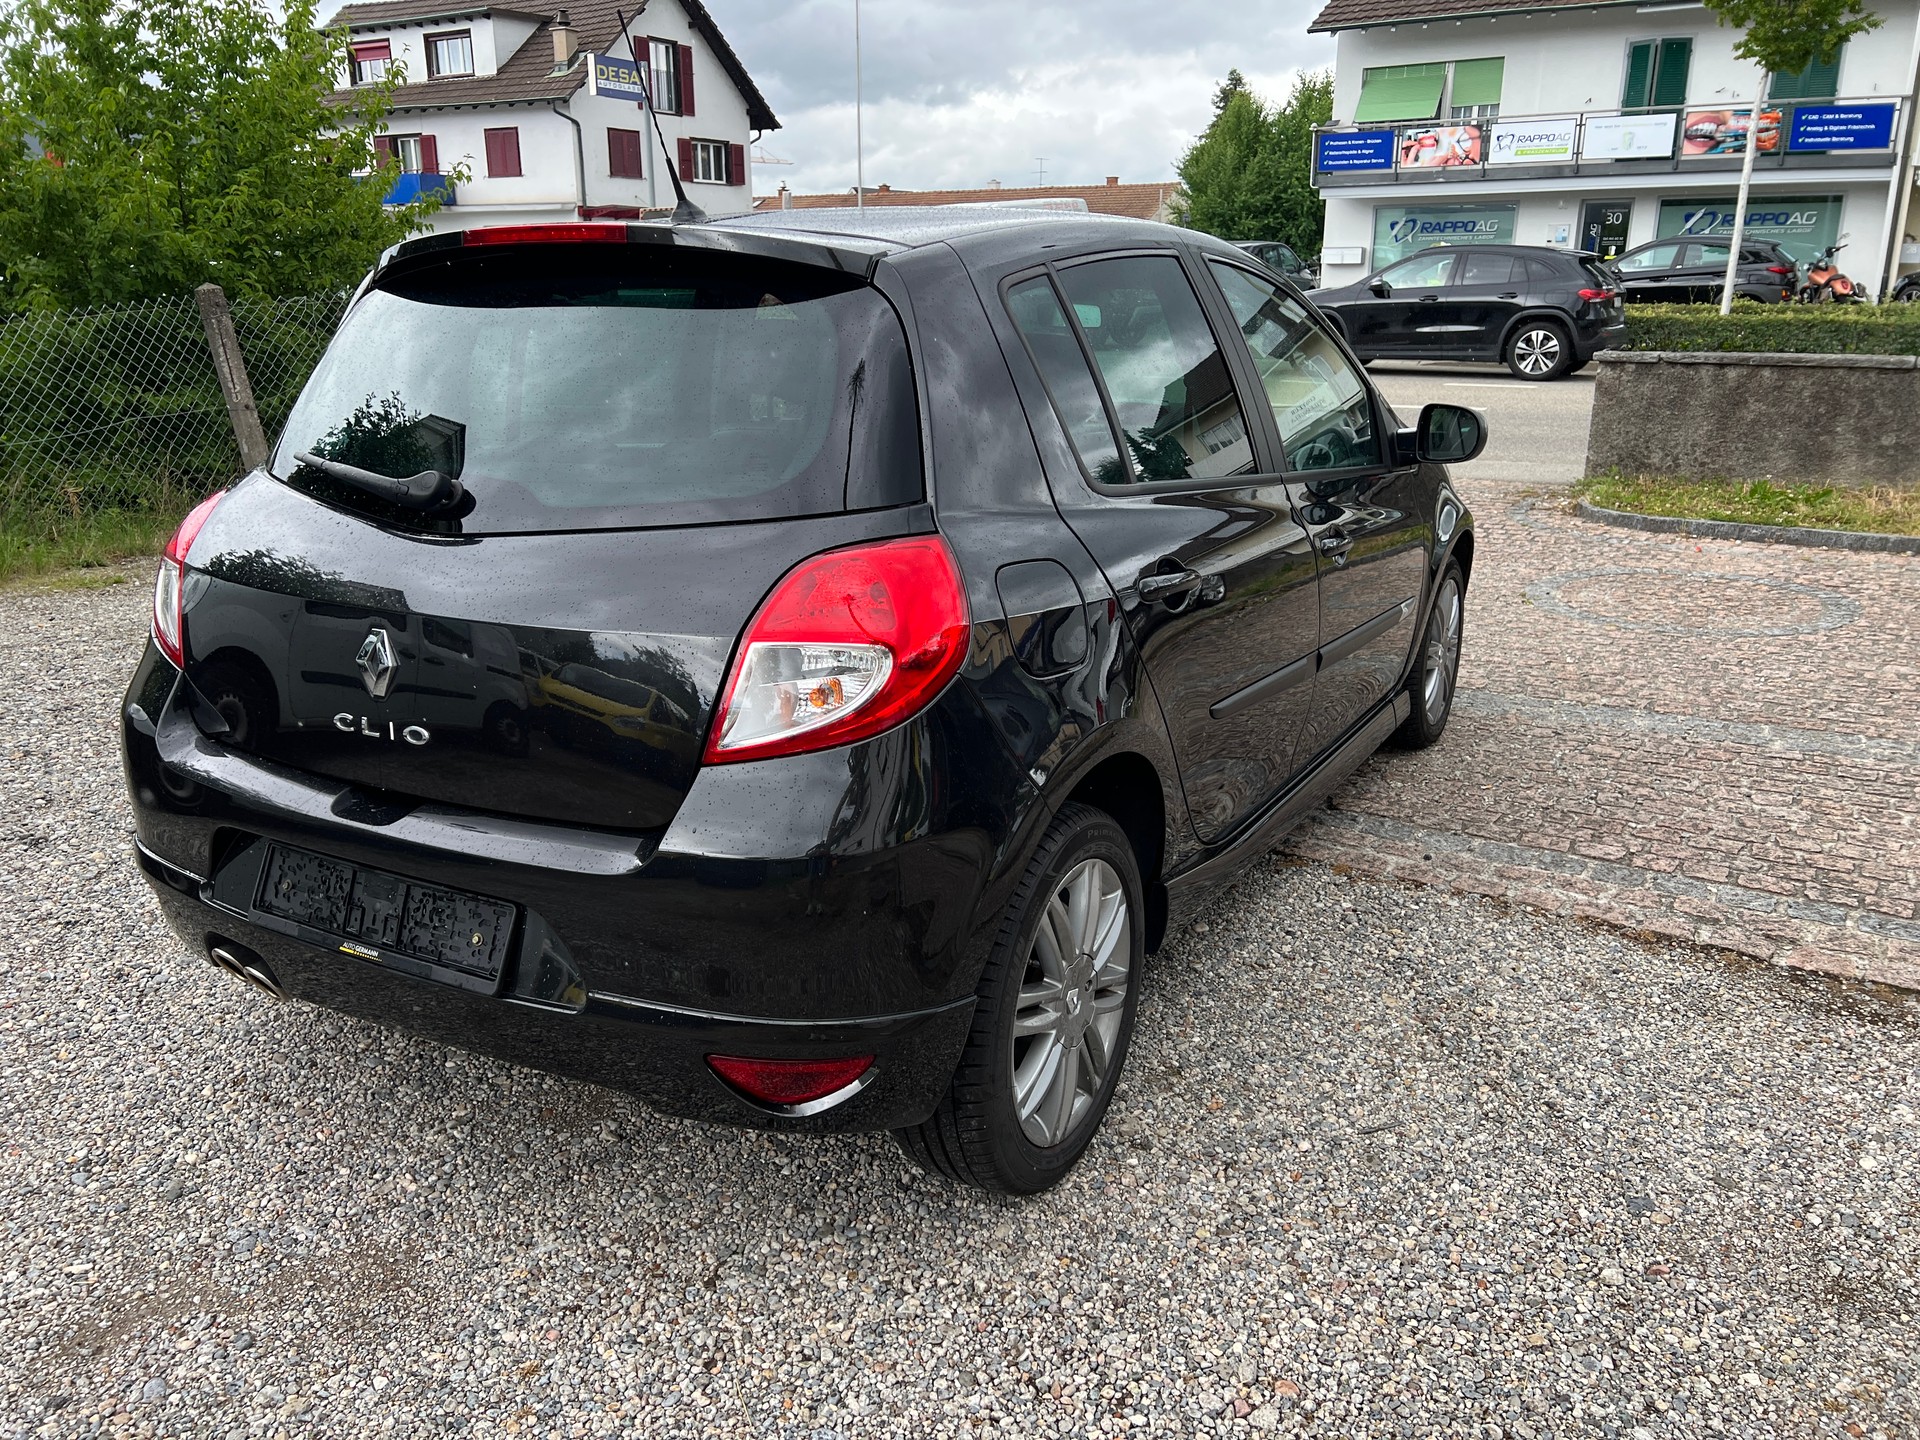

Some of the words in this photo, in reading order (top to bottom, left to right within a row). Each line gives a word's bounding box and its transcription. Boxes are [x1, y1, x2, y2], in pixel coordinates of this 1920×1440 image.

[596, 64, 640, 84] DESA
[597, 80, 641, 92] AUTOGLASS
[1606, 212, 1622, 224] 30
[333, 712, 430, 745] CLIO
[355, 946, 378, 957] GERMANN
